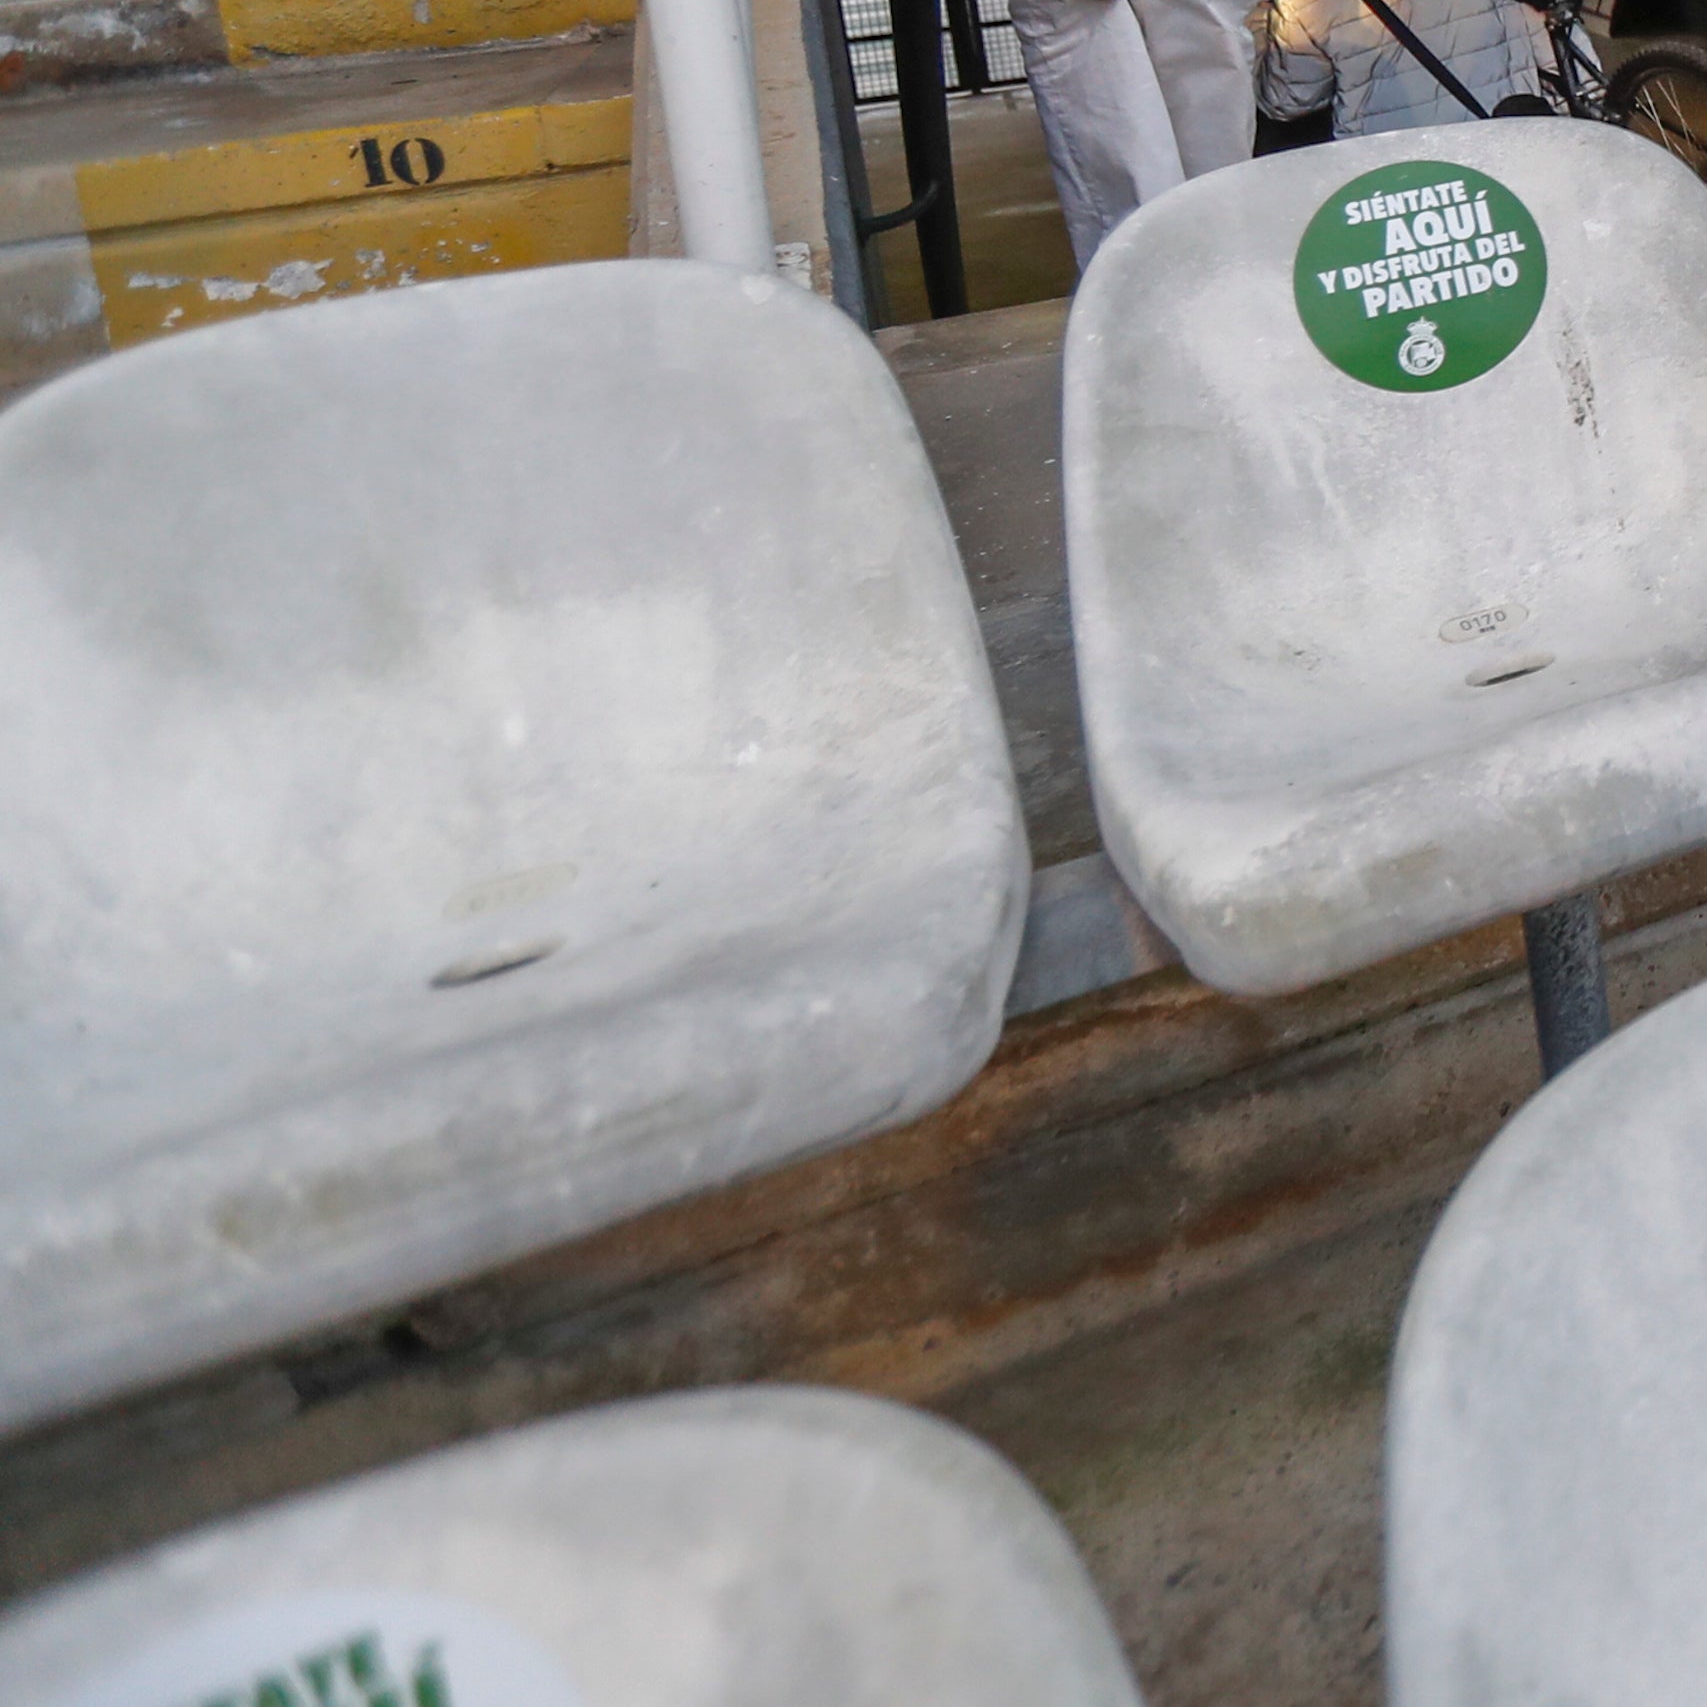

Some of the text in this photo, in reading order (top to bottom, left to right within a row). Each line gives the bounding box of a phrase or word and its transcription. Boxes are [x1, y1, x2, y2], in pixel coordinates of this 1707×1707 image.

[348, 136, 447, 189] 10
[1344, 180, 1468, 225] SIÉNTATE
[1384, 189, 1494, 256] AQUÍ
[1317, 230, 1525, 295] Y DISFRUTA DEL
[1362, 257, 1520, 319] PARTIDO
